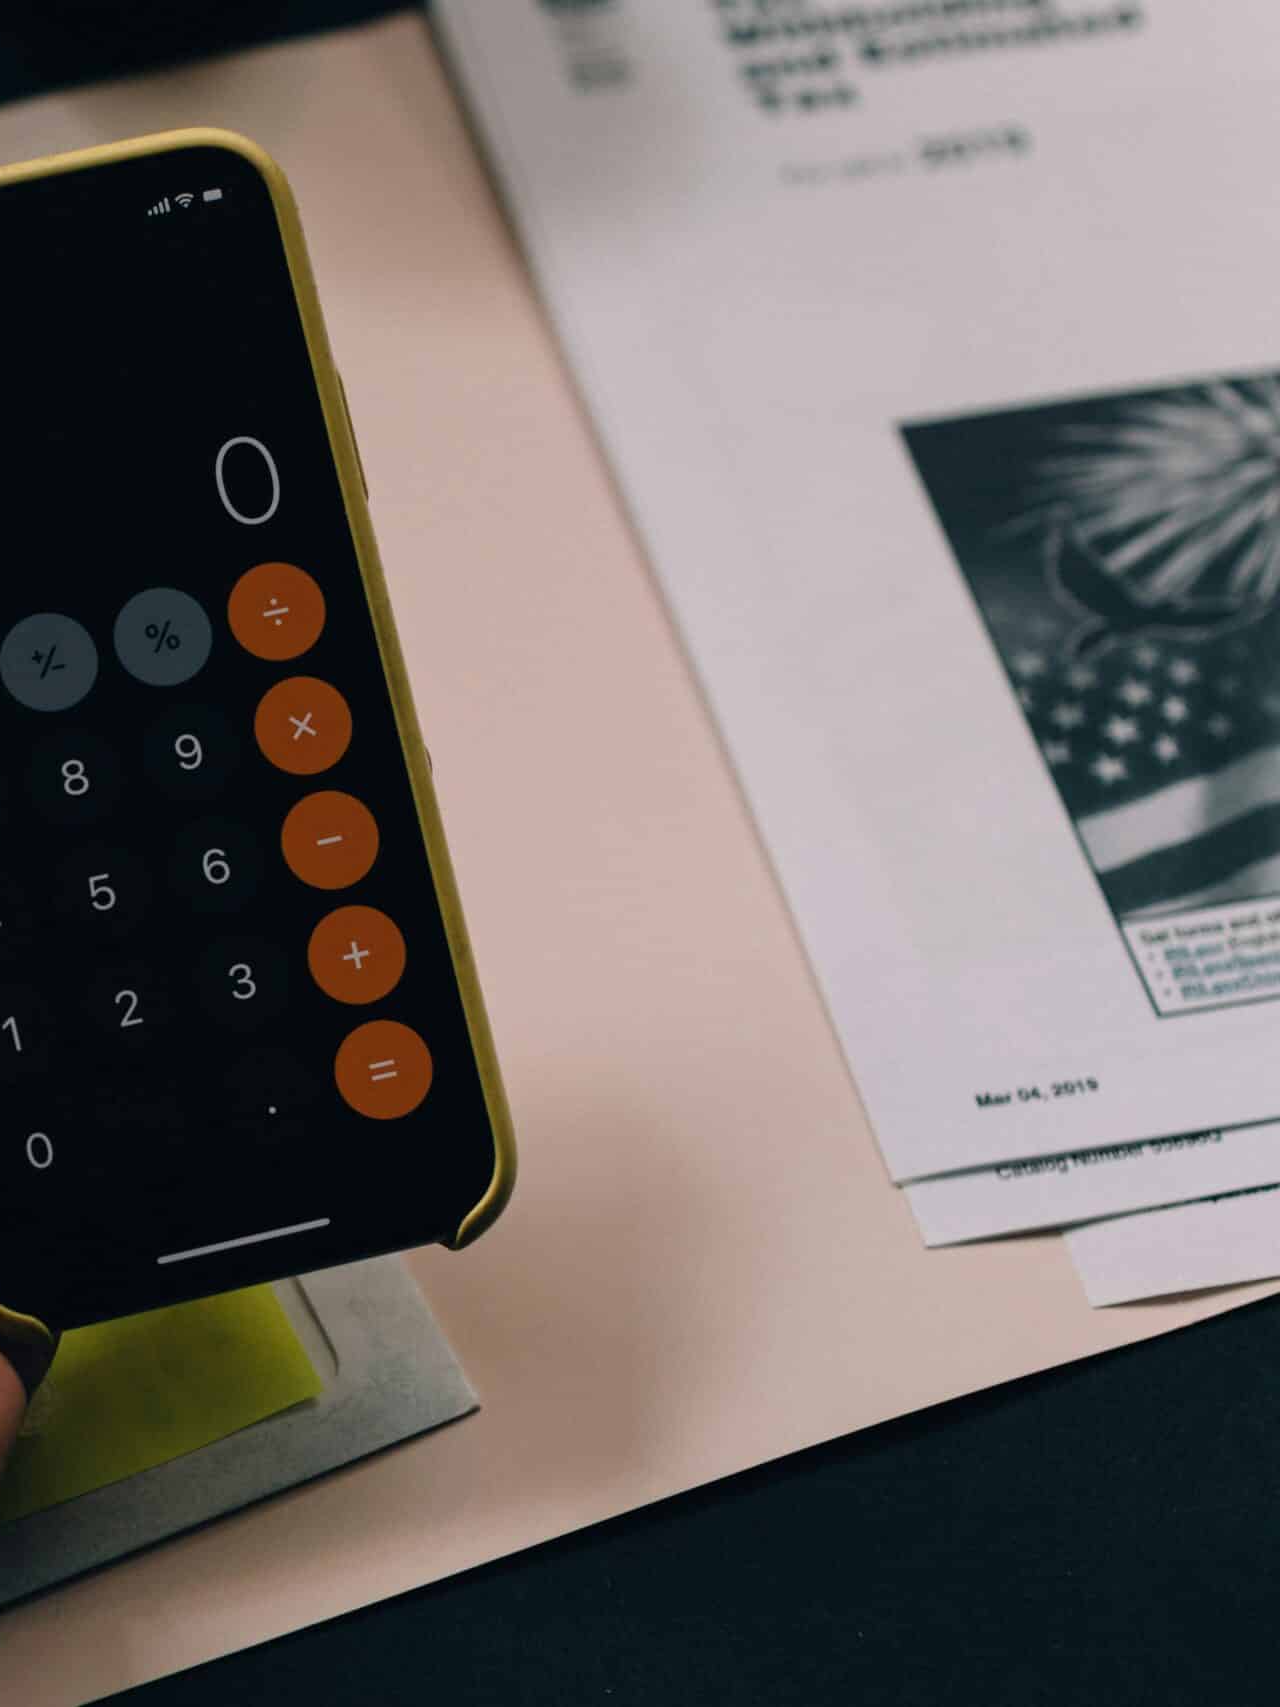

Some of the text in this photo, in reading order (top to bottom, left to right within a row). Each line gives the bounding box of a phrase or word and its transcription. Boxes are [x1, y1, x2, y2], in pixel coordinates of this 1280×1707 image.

[215, 436, 281, 525] 0
[144, 619, 181, 654] %
[262, 598, 290, 626] ÷
[61, 759, 90, 797] 8
[174, 734, 203, 770] 9
[88, 873, 117, 911] 5
[202, 848, 231, 885] 6
[1, 941, 370, 1052] 1 2 3 +
[26, 1132, 54, 1169] 0
[368, 1059, 398, 1082] =
[975, 1078, 1099, 1109] Mar 04, 2019
